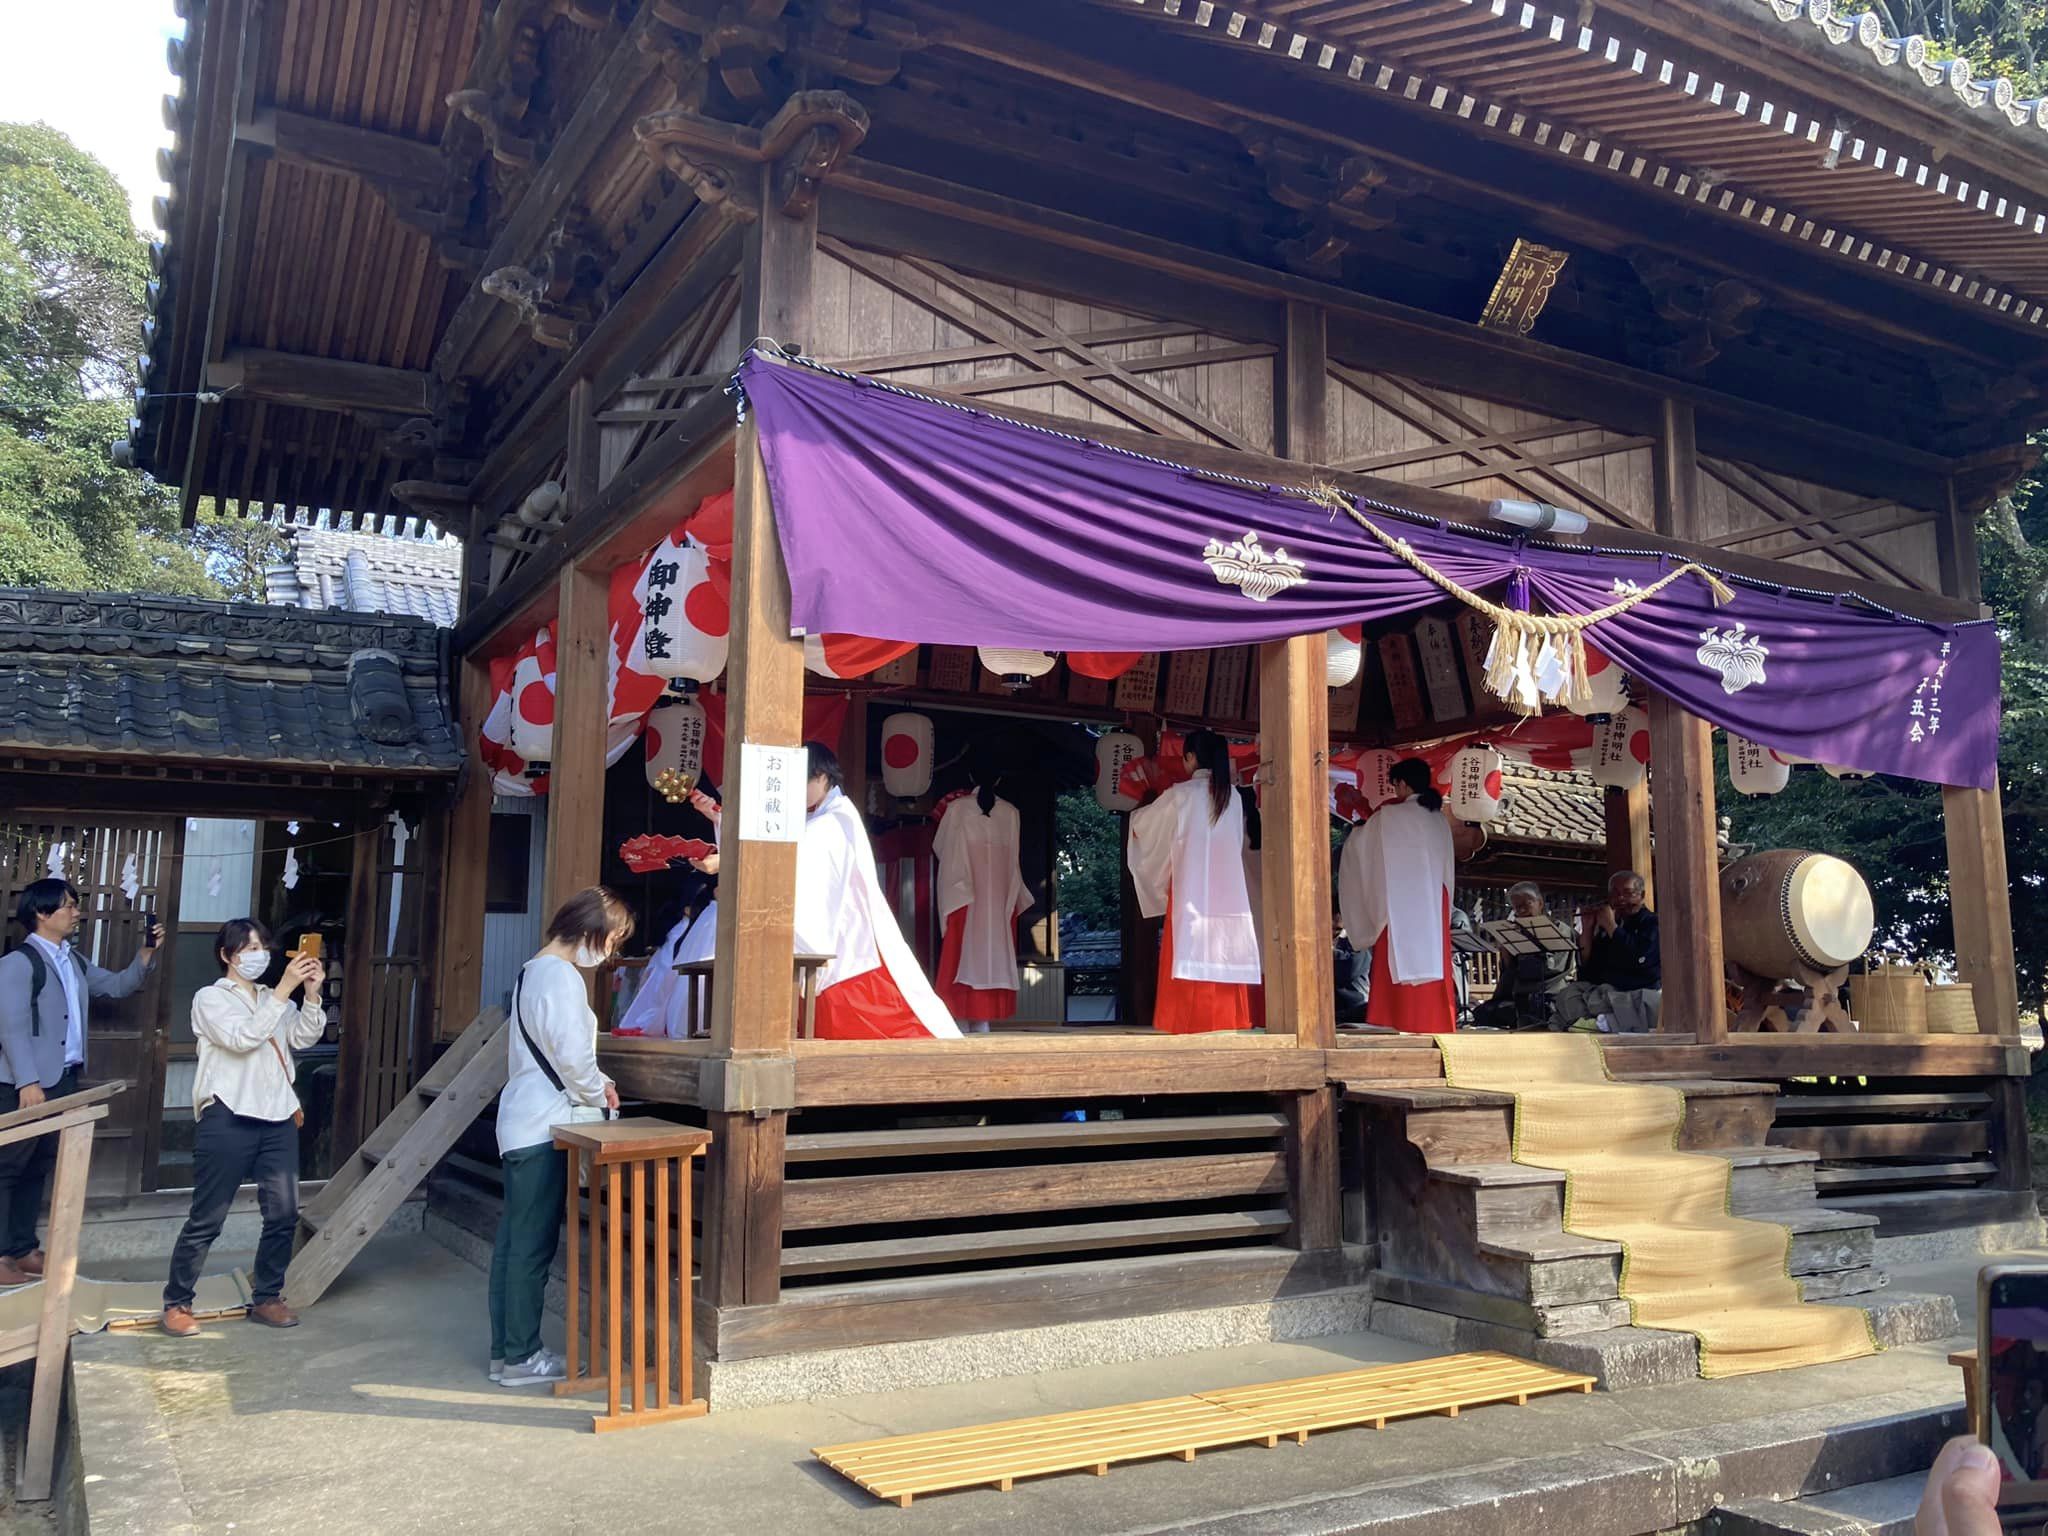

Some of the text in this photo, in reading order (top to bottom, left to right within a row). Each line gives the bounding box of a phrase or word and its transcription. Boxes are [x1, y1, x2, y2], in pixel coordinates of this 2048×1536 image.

[1494, 262, 1535, 325] 神明社
[765, 755, 783, 834] お鈴祓い
[1467, 755, 1481, 799] 谷田神明社
